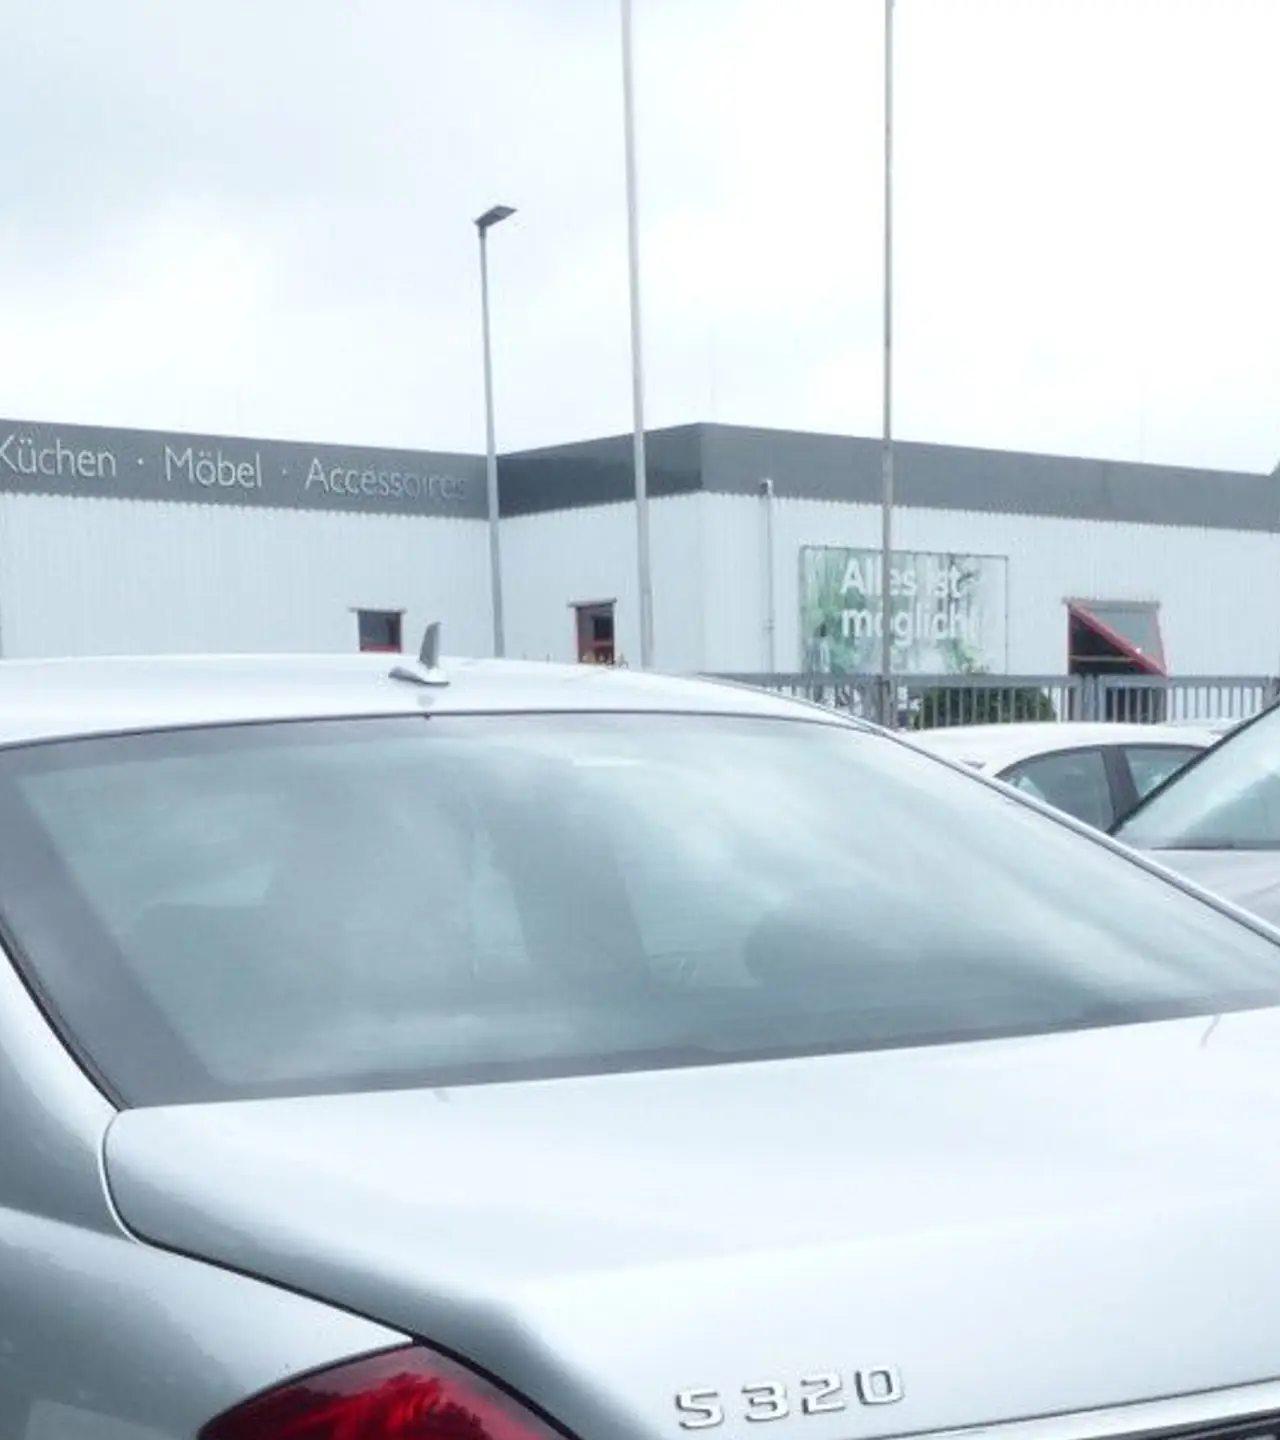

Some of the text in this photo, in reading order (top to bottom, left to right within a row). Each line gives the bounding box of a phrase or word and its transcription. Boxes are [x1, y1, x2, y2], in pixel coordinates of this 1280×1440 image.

[165, 445, 262, 489] Möbel
[304, 457, 468, 500] Accessoires
[840, 558, 917, 597] Alles
[675, 1365, 905, 1430] S 320
